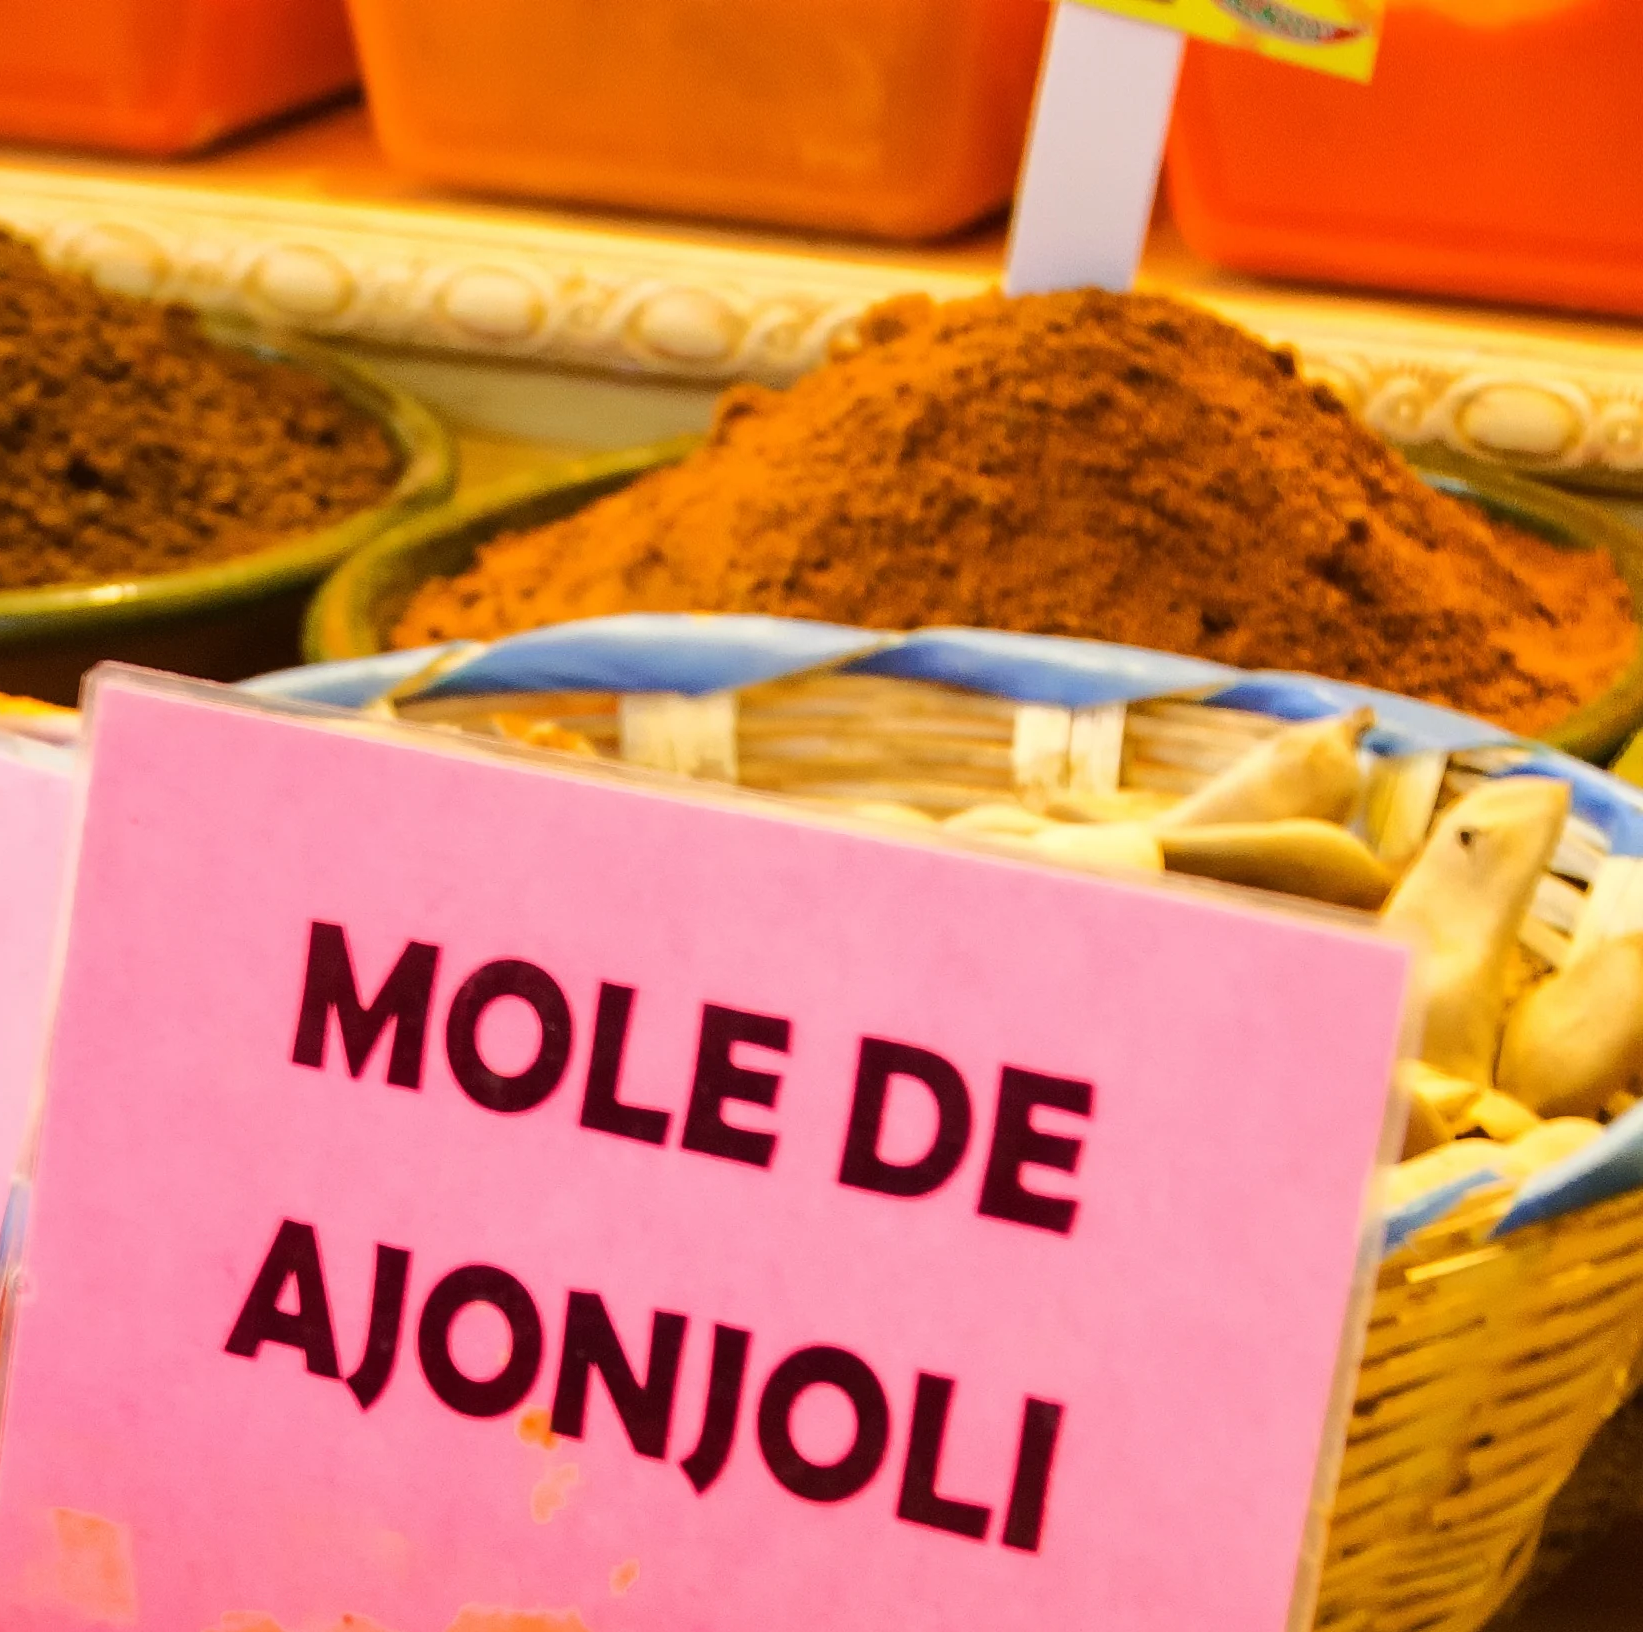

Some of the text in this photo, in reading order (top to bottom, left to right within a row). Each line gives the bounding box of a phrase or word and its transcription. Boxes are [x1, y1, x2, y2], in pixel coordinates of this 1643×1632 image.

[291, 920, 1094, 1236] MOLE DE
[223, 1218, 1064, 1553] AJONJOLI
